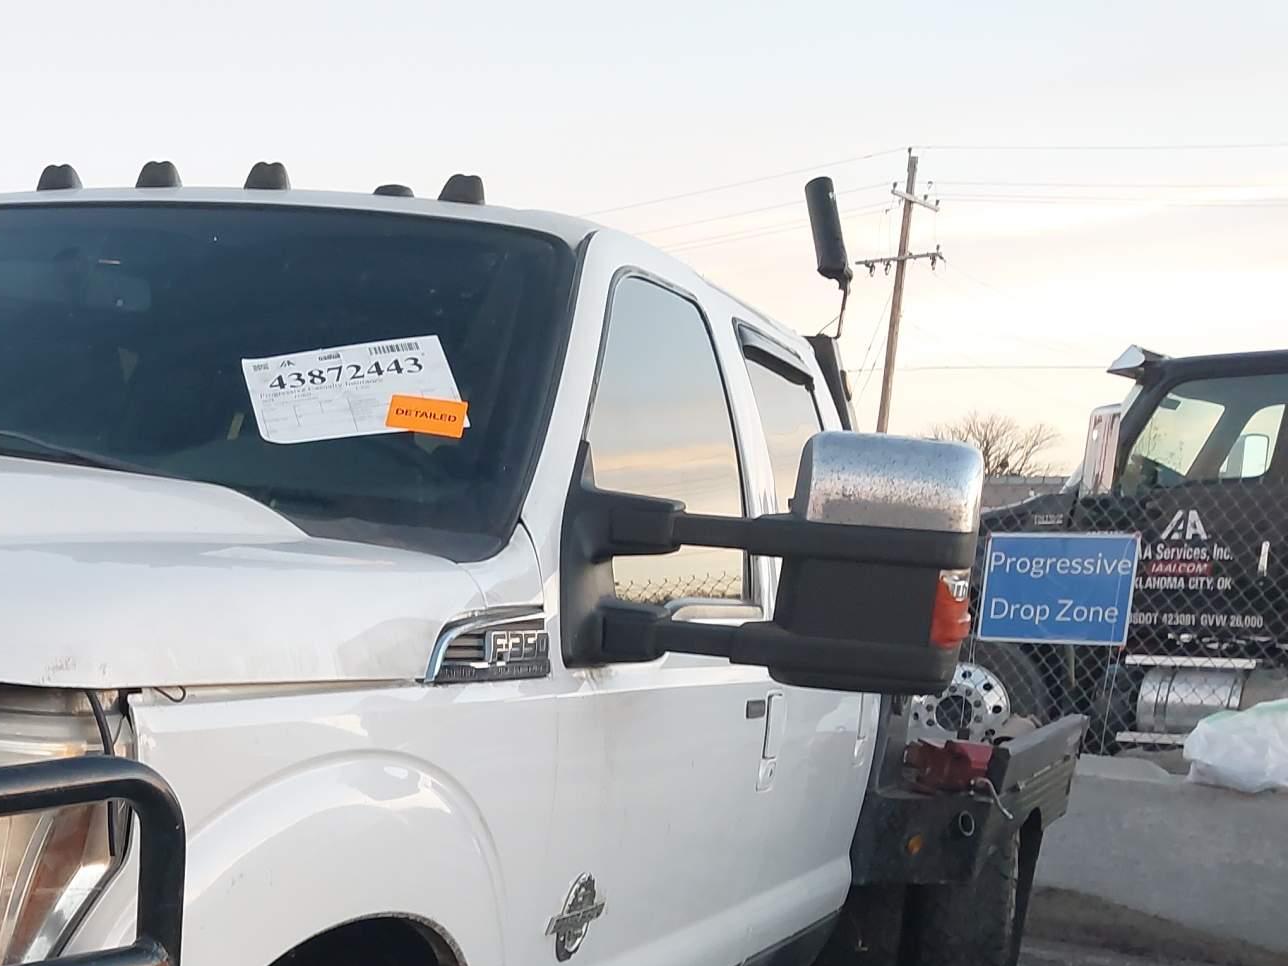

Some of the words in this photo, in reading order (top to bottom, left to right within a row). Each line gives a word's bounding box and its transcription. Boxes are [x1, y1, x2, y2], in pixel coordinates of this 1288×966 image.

[269, 357, 423, 390] 43872443
[395, 407, 457, 423] DETAILED
[1156, 543, 1210, 562] Services,
[1213, 543, 1233, 560] Inc.
[990, 551, 1132, 579] Progressive
[1133, 576, 1185, 590] KLAHOMA
[1188, 576, 1214, 591] CITY,
[1217, 576, 1232, 590] OK
[990, 597, 1050, 625] Drop
[1055, 598, 1119, 624] Zone
[1200, 614, 1228, 627] GVW
